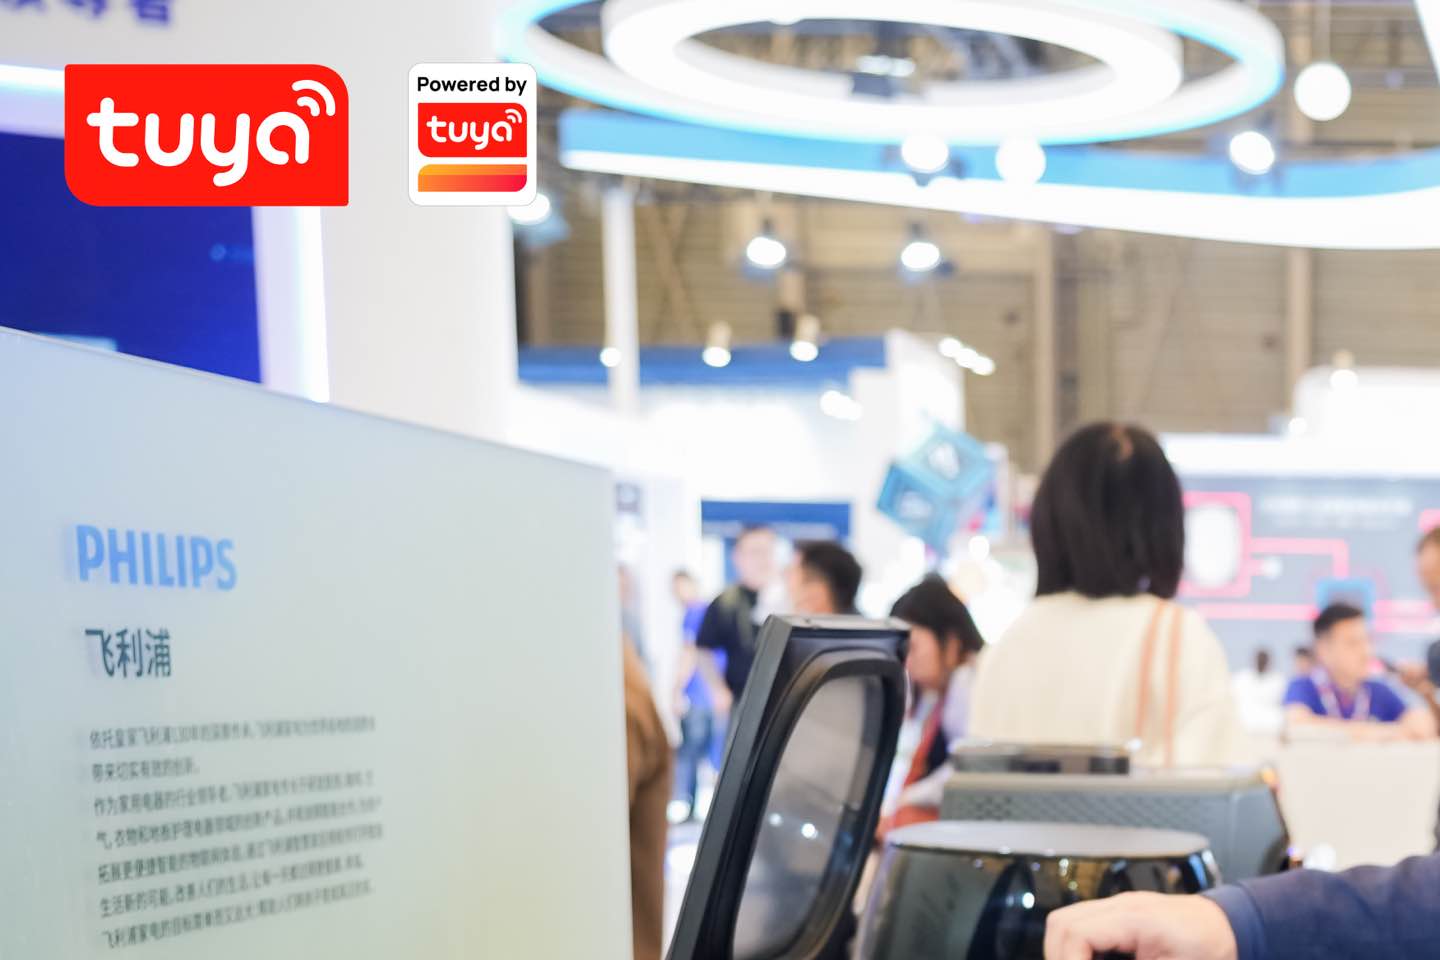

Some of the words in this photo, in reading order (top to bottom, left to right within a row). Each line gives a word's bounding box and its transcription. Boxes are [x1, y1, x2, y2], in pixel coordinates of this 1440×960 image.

[76, 524, 238, 592] PHILIPS
[84, 628, 172, 679] 飞利浦
